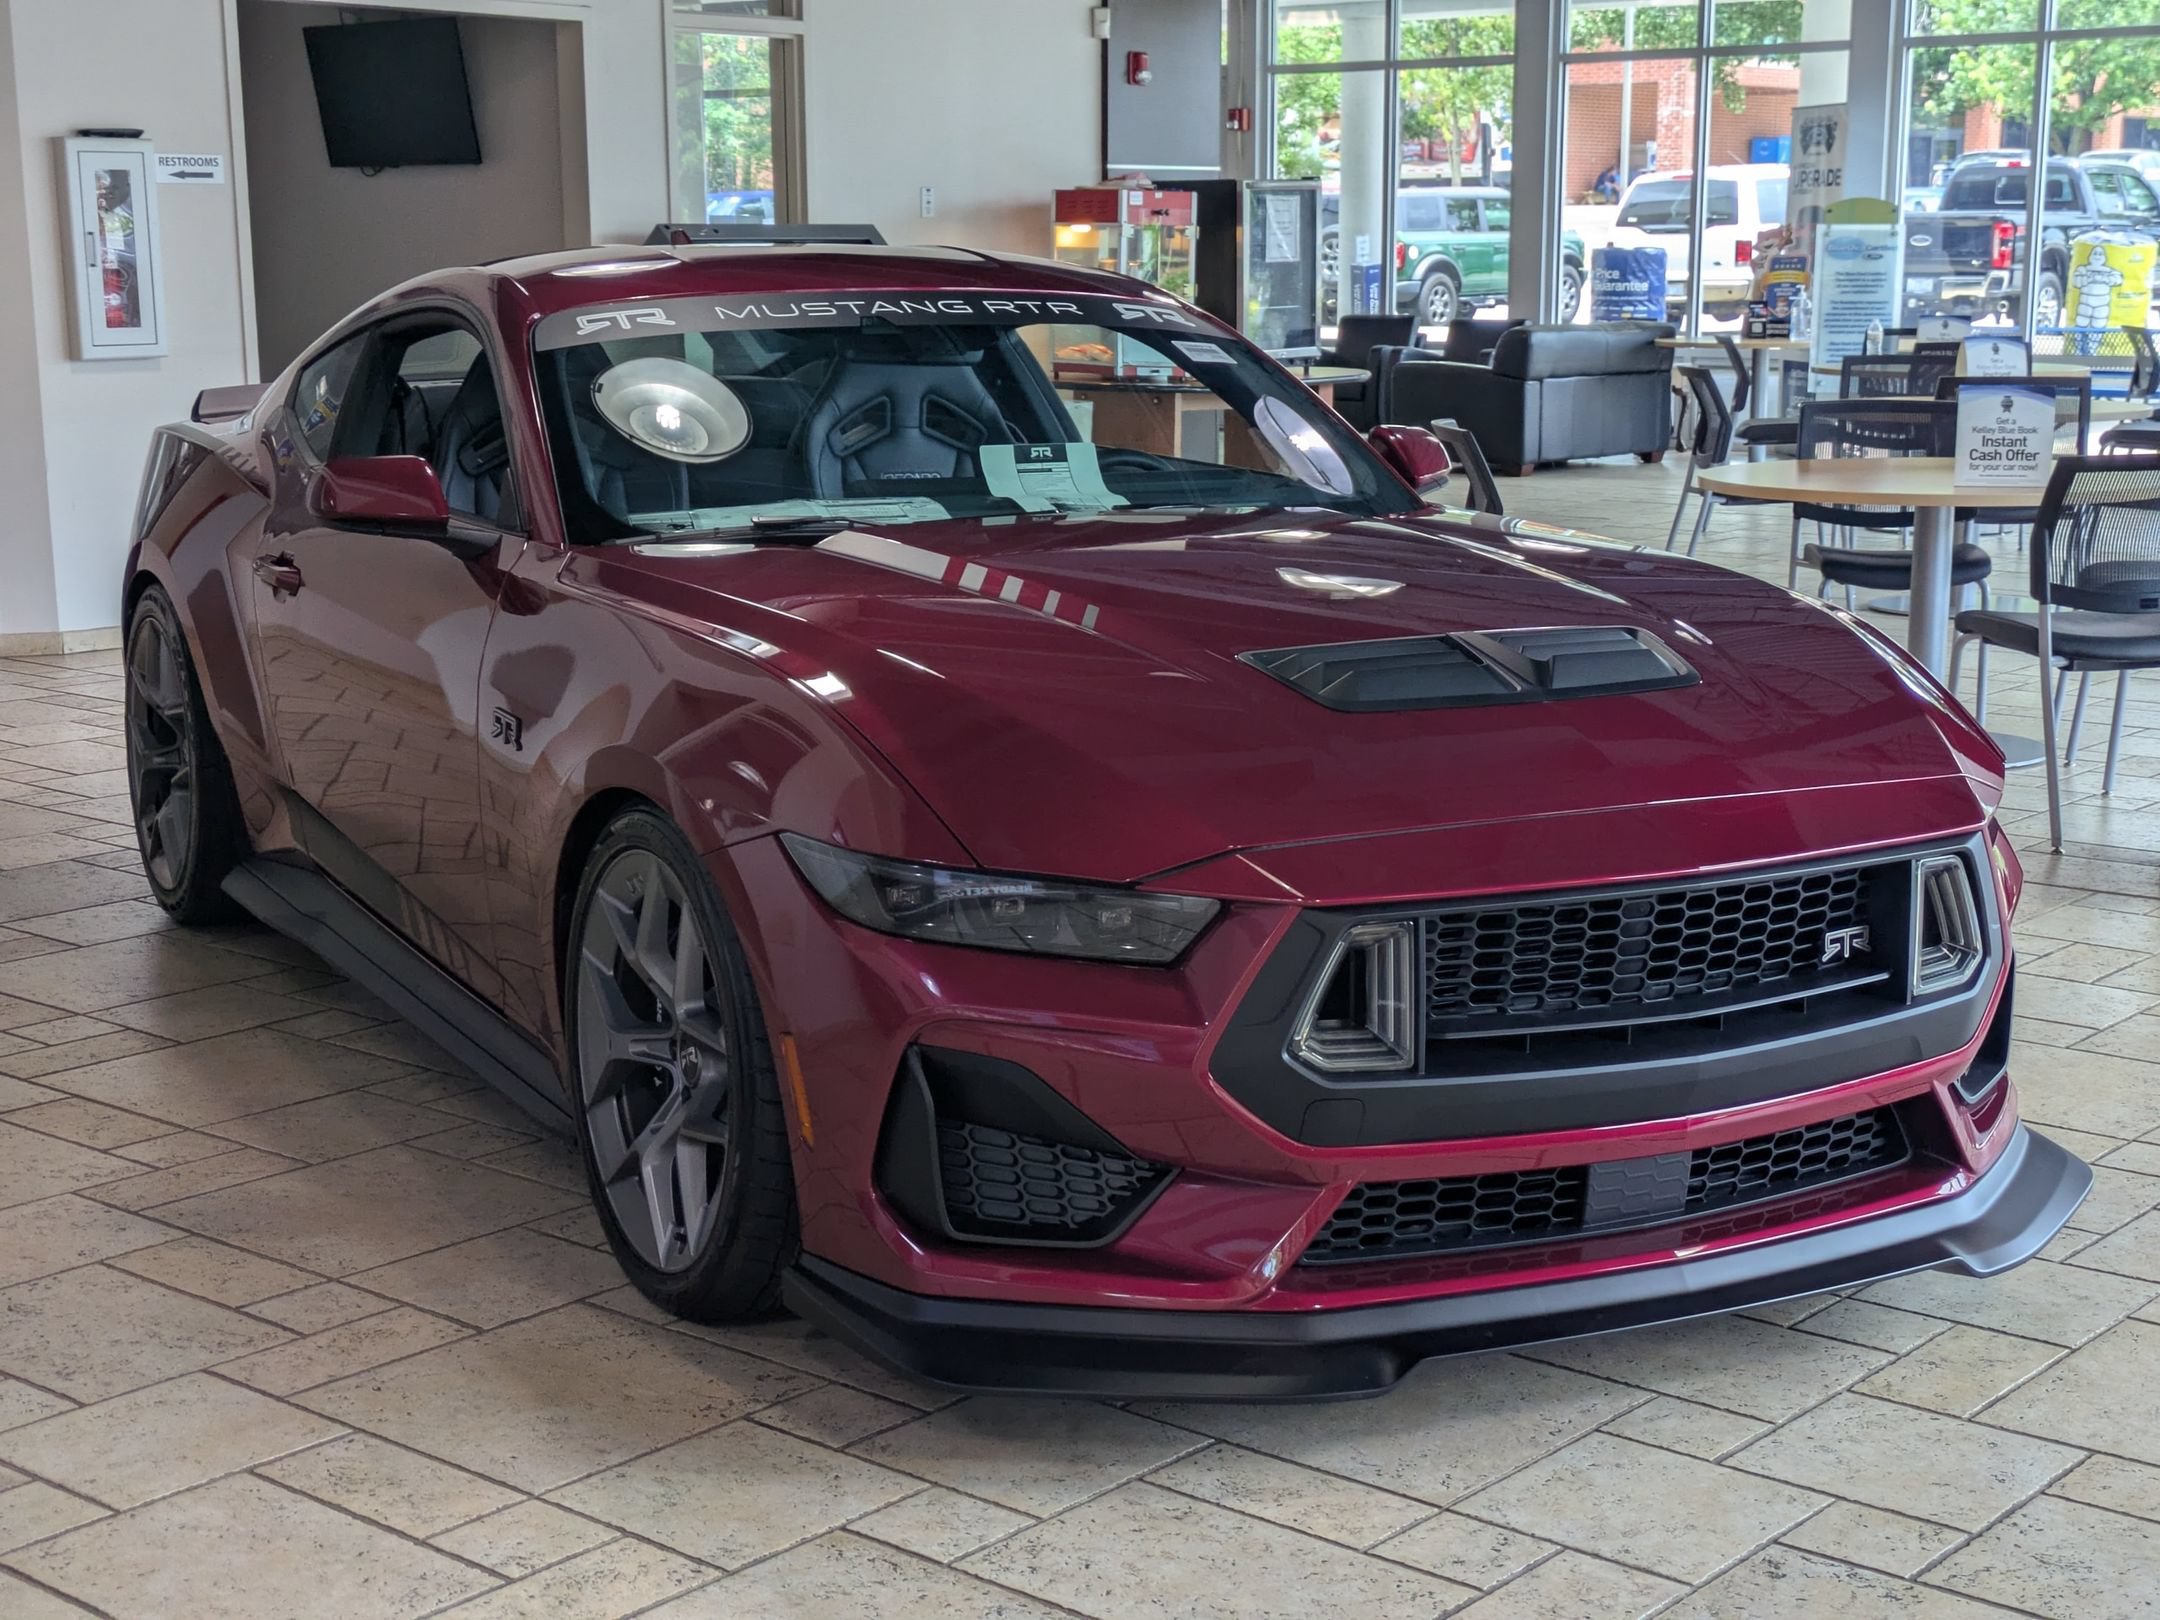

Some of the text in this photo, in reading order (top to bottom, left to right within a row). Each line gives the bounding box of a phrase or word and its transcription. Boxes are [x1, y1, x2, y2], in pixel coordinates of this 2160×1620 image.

[158, 156, 219, 168] RESTROOMS
[714, 300, 1084, 320] MUSTANG RTR
[576, 307, 676, 335] RTR
[1995, 417, 2010, 425] Get
[1972, 426, 2038, 435] Kelley Blue Book
[1981, 435, 2028, 448] Instant
[1969, 448, 2040, 461] Cash Offer
[1969, 462, 1981, 471] for
[1982, 463, 2001, 472] your
[2017, 463, 2039, 471] now!
[1822, 925, 1872, 962] RTR
